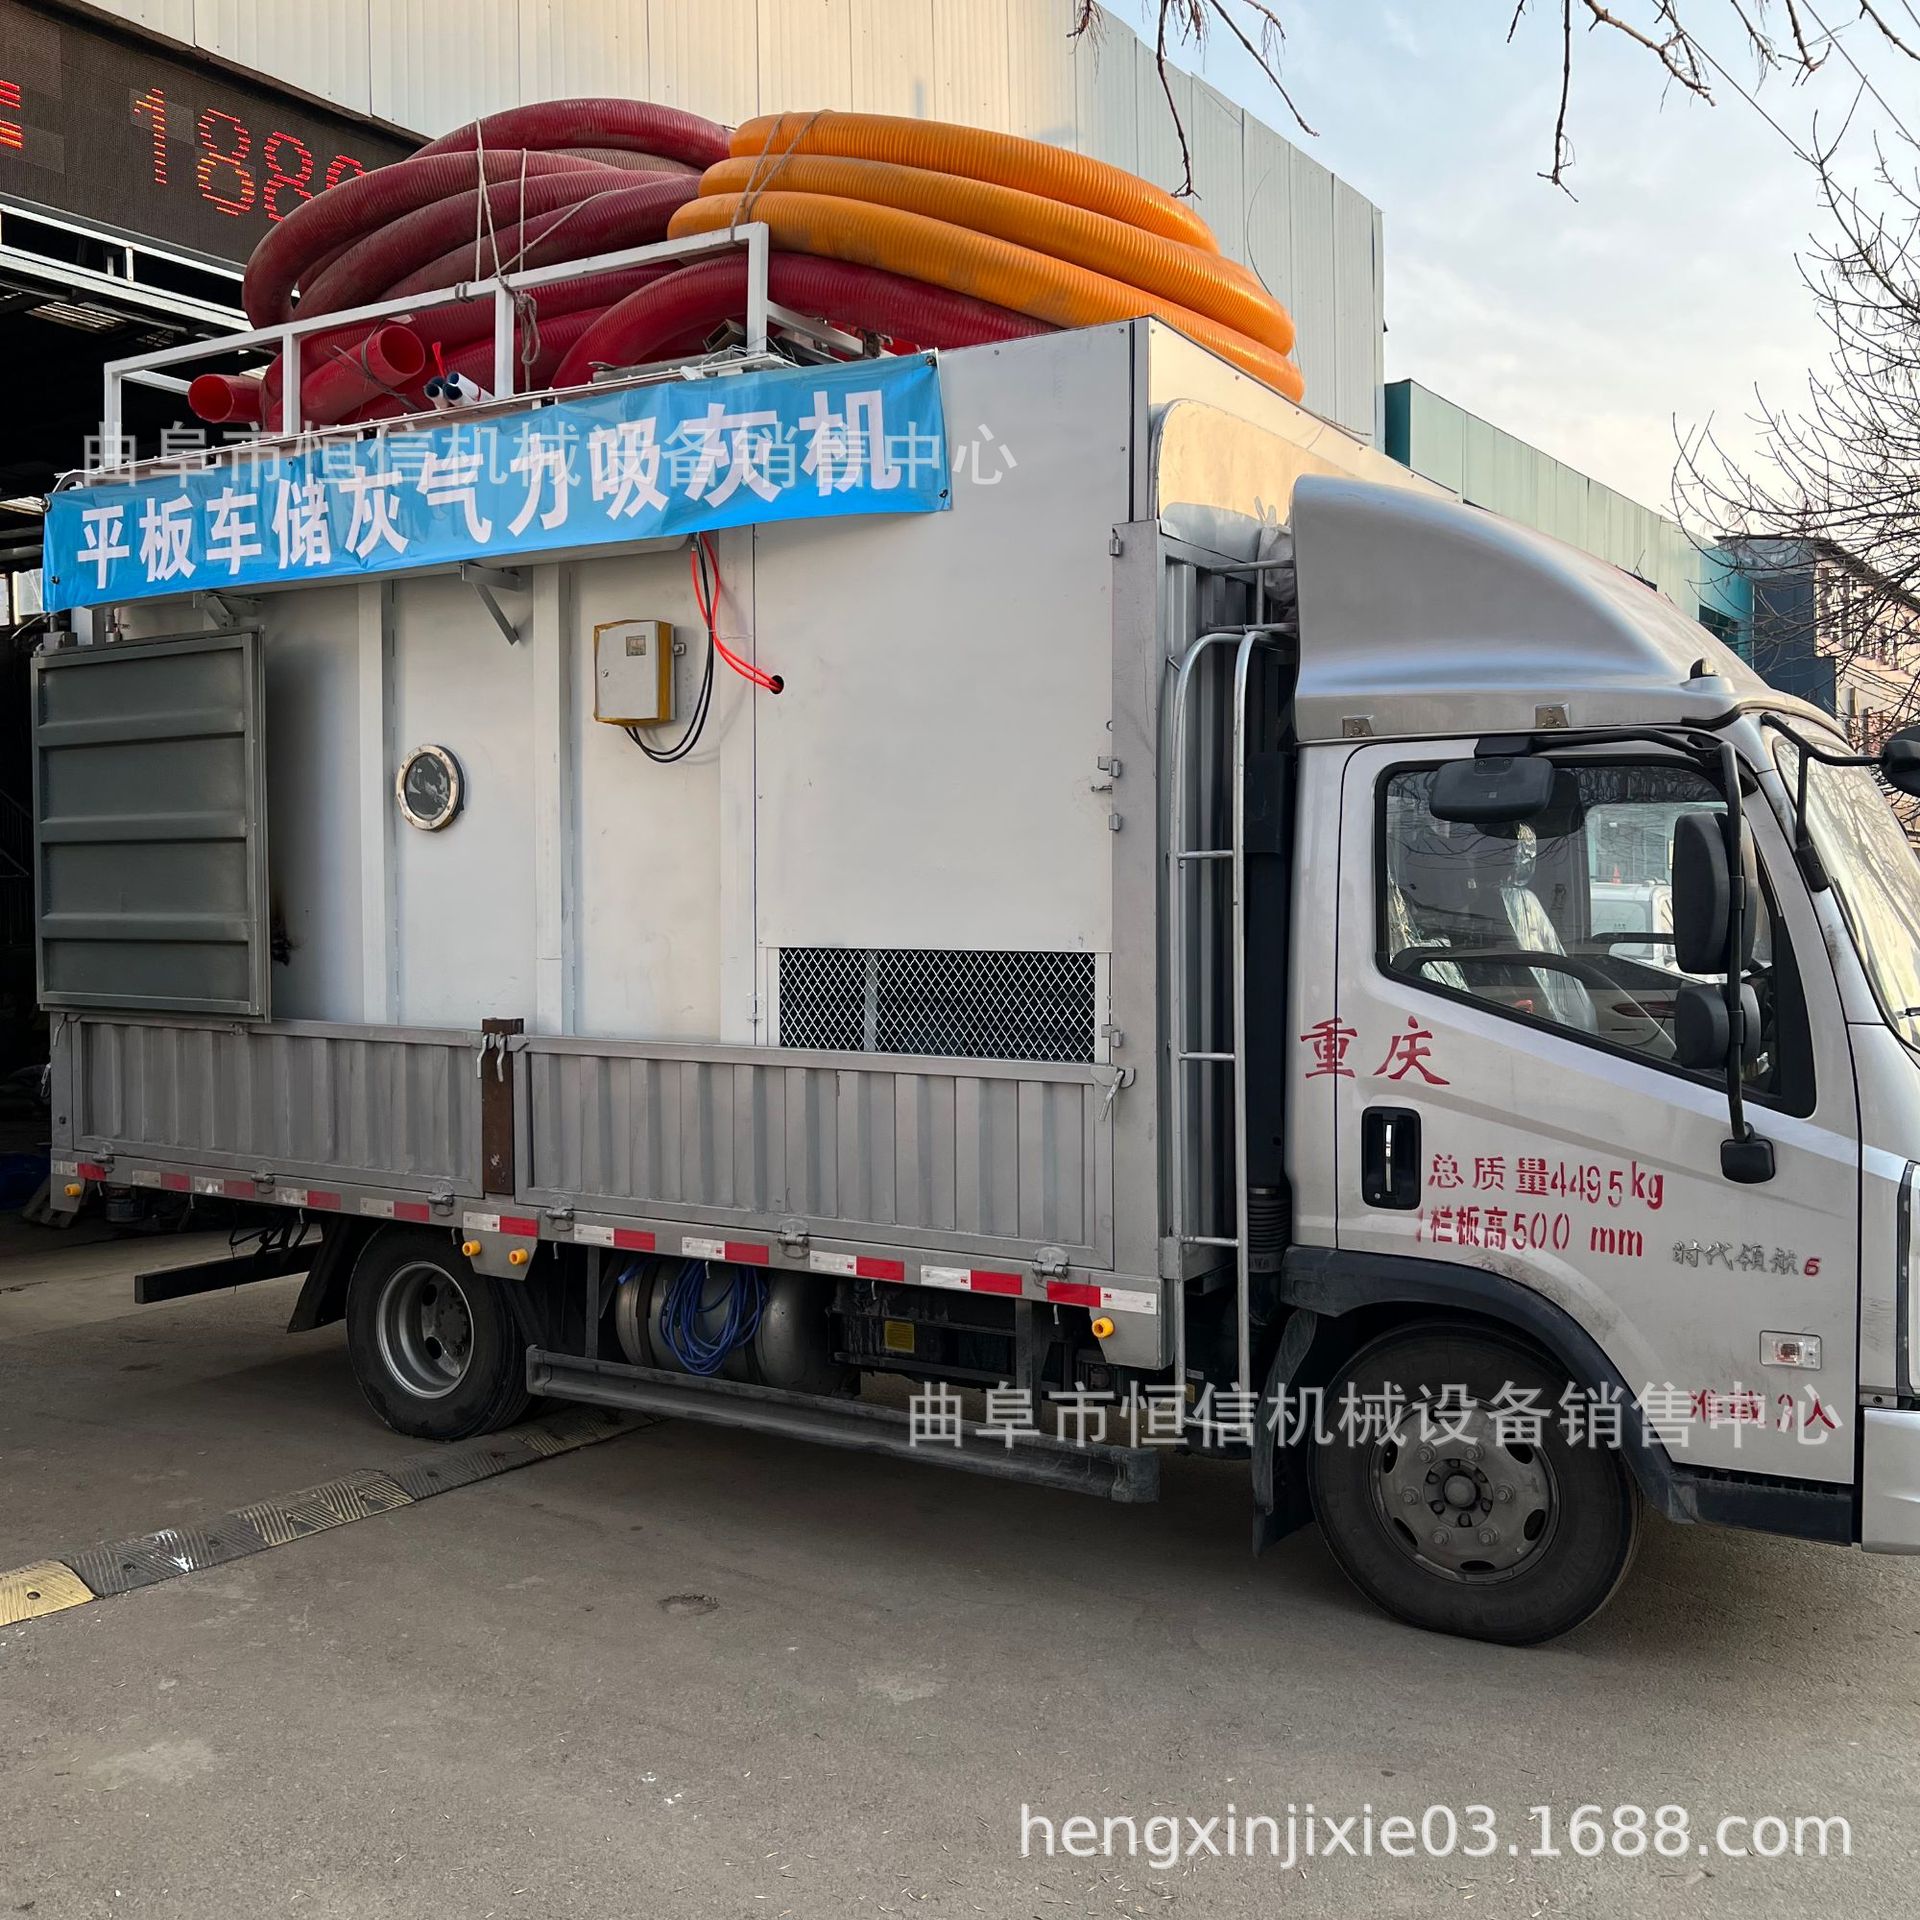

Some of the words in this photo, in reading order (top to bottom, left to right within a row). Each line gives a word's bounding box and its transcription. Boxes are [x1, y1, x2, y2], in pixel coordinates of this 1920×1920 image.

[77, 390, 901, 589] 平板车储灰气力吸灰机
[1301, 1016, 1450, 1085] 重庆
[1590, 1226, 1643, 1257] mm
